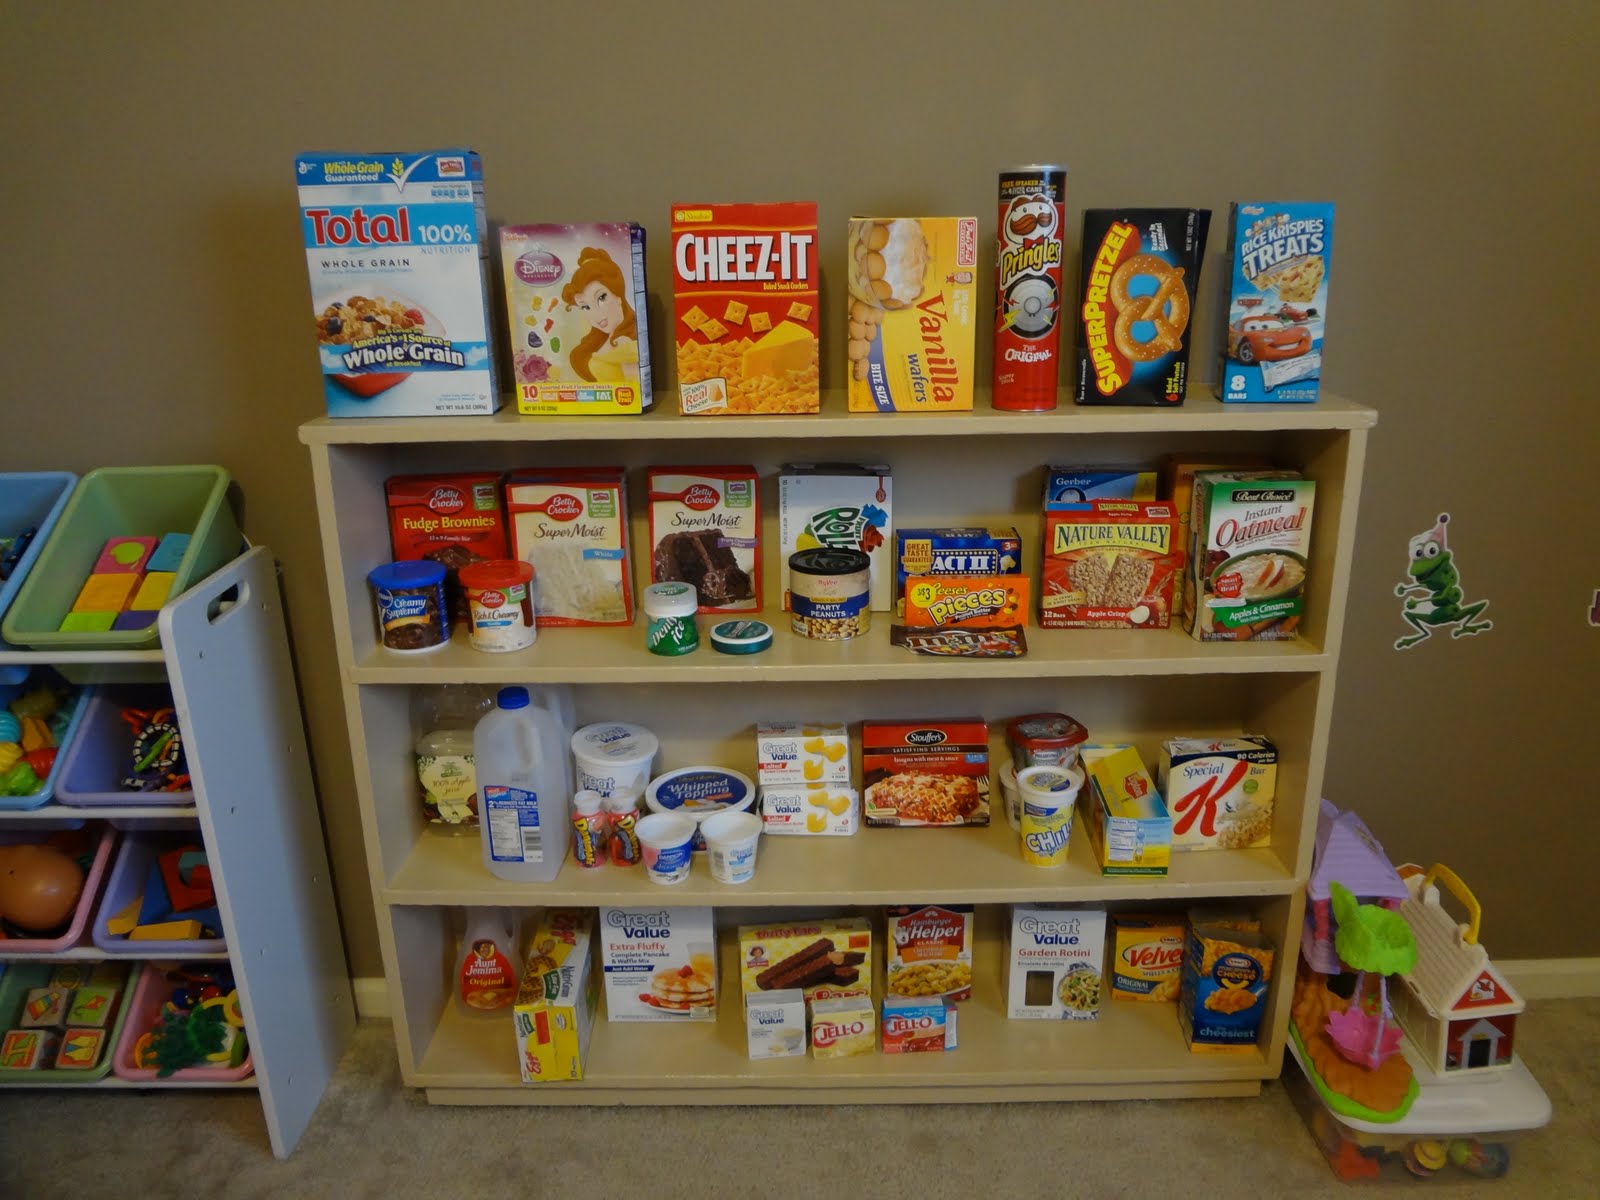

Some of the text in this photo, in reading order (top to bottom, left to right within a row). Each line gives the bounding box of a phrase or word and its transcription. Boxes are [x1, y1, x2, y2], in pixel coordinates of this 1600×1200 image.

[323, 161, 357, 174] Whole
[357, 161, 385, 173] Grain
[324, 173, 380, 183] Guaranteed
[1026, 186, 1043, 194] CANS
[305, 206, 411, 245] Total
[418, 223, 472, 243] 100%
[1242, 219, 1324, 255] RICE KRISPIES
[420, 246, 471, 255] NUTRITION
[1243, 233, 1324, 280] TREATS
[321, 258, 411, 268] WHOLE GRAIN
[675, 232, 813, 282] CHEEZ-IT
[1002, 238, 1060, 286] Pringles
[763, 282, 809, 290] Baked Snack Crackers
[1084, 223, 1133, 394] SUPERPRETZEL
[352, 333, 443, 350] America's Source
[916, 290, 959, 403] Vanilla
[343, 343, 465, 370] Whole Grain
[1005, 349, 1052, 363] ORIGINAL
[907, 353, 929, 403] wafers
[1172, 361, 1181, 383] Pretzels
[870, 363, 890, 405] BITE SIZE
[1230, 375, 1246, 391] 8
[522, 385, 539, 400] 10
[685, 386, 708, 406] Real
[1165, 391, 1178, 402] 6
[1228, 392, 1247, 400] BARS
[1056, 477, 1092, 486] Gerber
[435, 488, 459, 500] Betty
[690, 486, 713, 498] Betty
[1236, 490, 1293, 501] Best Choice
[429, 498, 464, 510] Crocker
[553, 497, 575, 508] Betty
[685, 495, 717, 505] Crocker
[547, 505, 579, 515] Crocker
[1244, 504, 1282, 522] Instant
[403, 516, 495, 533] Fudge Brownies
[855, 517, 866, 541] FRUIT
[1216, 507, 1307, 548] Oatmeal
[1057, 526, 1169, 549] NATURE VALLEY
[906, 543, 930, 551] GREAT
[1004, 541, 1011, 550] 3
[594, 550, 613, 558] White
[932, 556, 990, 570] ACT II
[394, 597, 426, 610] Creamy
[385, 606, 421, 619] Supreme
[475, 609, 519, 621] Rich Creamy
[955, 607, 992, 620] Peanut Butter
[1044, 610, 1052, 618] 12
[1087, 610, 1126, 618] Apple Crisp
[1229, 609, 1252, 622] Apples
[1259, 601, 1294, 614] Cinnamon
[671, 621, 686, 645] ice
[600, 732, 631, 744] Value
[910, 731, 942, 743] Stouffer's
[762, 743, 797, 754] Great
[1237, 752, 1275, 760] 90 Calories
[1183, 762, 1224, 779] Special
[1249, 767, 1266, 775] Bar
[668, 778, 728, 794] Whipped
[675, 786, 730, 799] Topping
[1173, 760, 1249, 837] K
[766, 795, 801, 806] Great
[775, 805, 801, 813] Value
[607, 909, 670, 928] Great
[910, 917, 952, 927] Hamburger
[1019, 916, 1080, 934] Great
[623, 927, 670, 938] Value
[912, 924, 961, 940] Helper
[1034, 934, 1079, 945] Value
[610, 942, 665, 952] Extra Fluffy
[1018, 948, 1091, 957] Garden Rotini
[474, 958, 497, 967] Aunt
[466, 965, 502, 976] Jemima
[1217, 969, 1256, 980] Cheese
[469, 978, 505, 986] Original
[1117, 976, 1150, 989] ORIGINAL
[750, 1009, 784, 1020] Great
[759, 1017, 784, 1025] Value
[1200, 1027, 1255, 1039] cheesiest
[525, 1050, 542, 1075] Eggo
